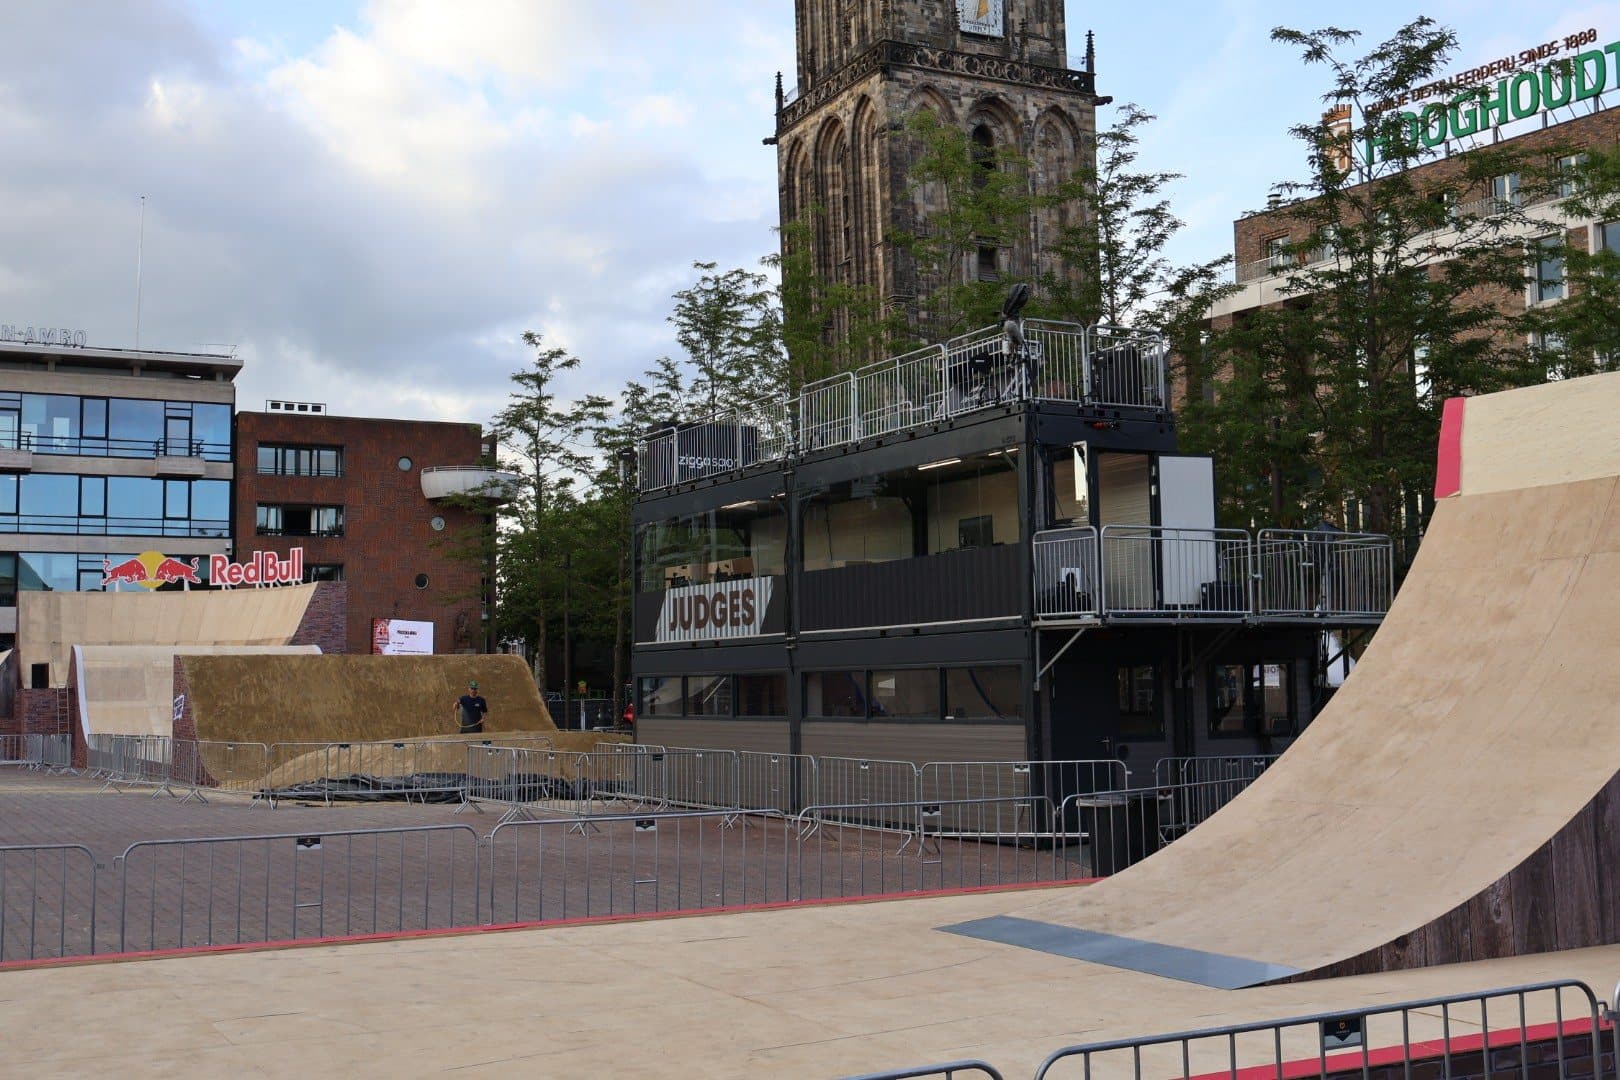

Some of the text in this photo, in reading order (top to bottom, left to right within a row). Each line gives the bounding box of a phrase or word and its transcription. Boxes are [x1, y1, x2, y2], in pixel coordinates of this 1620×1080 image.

[1519, 40, 1558, 66] SINDS
[1563, 28, 1597, 51] 1888
[669, 588, 756, 632] JUDGES
